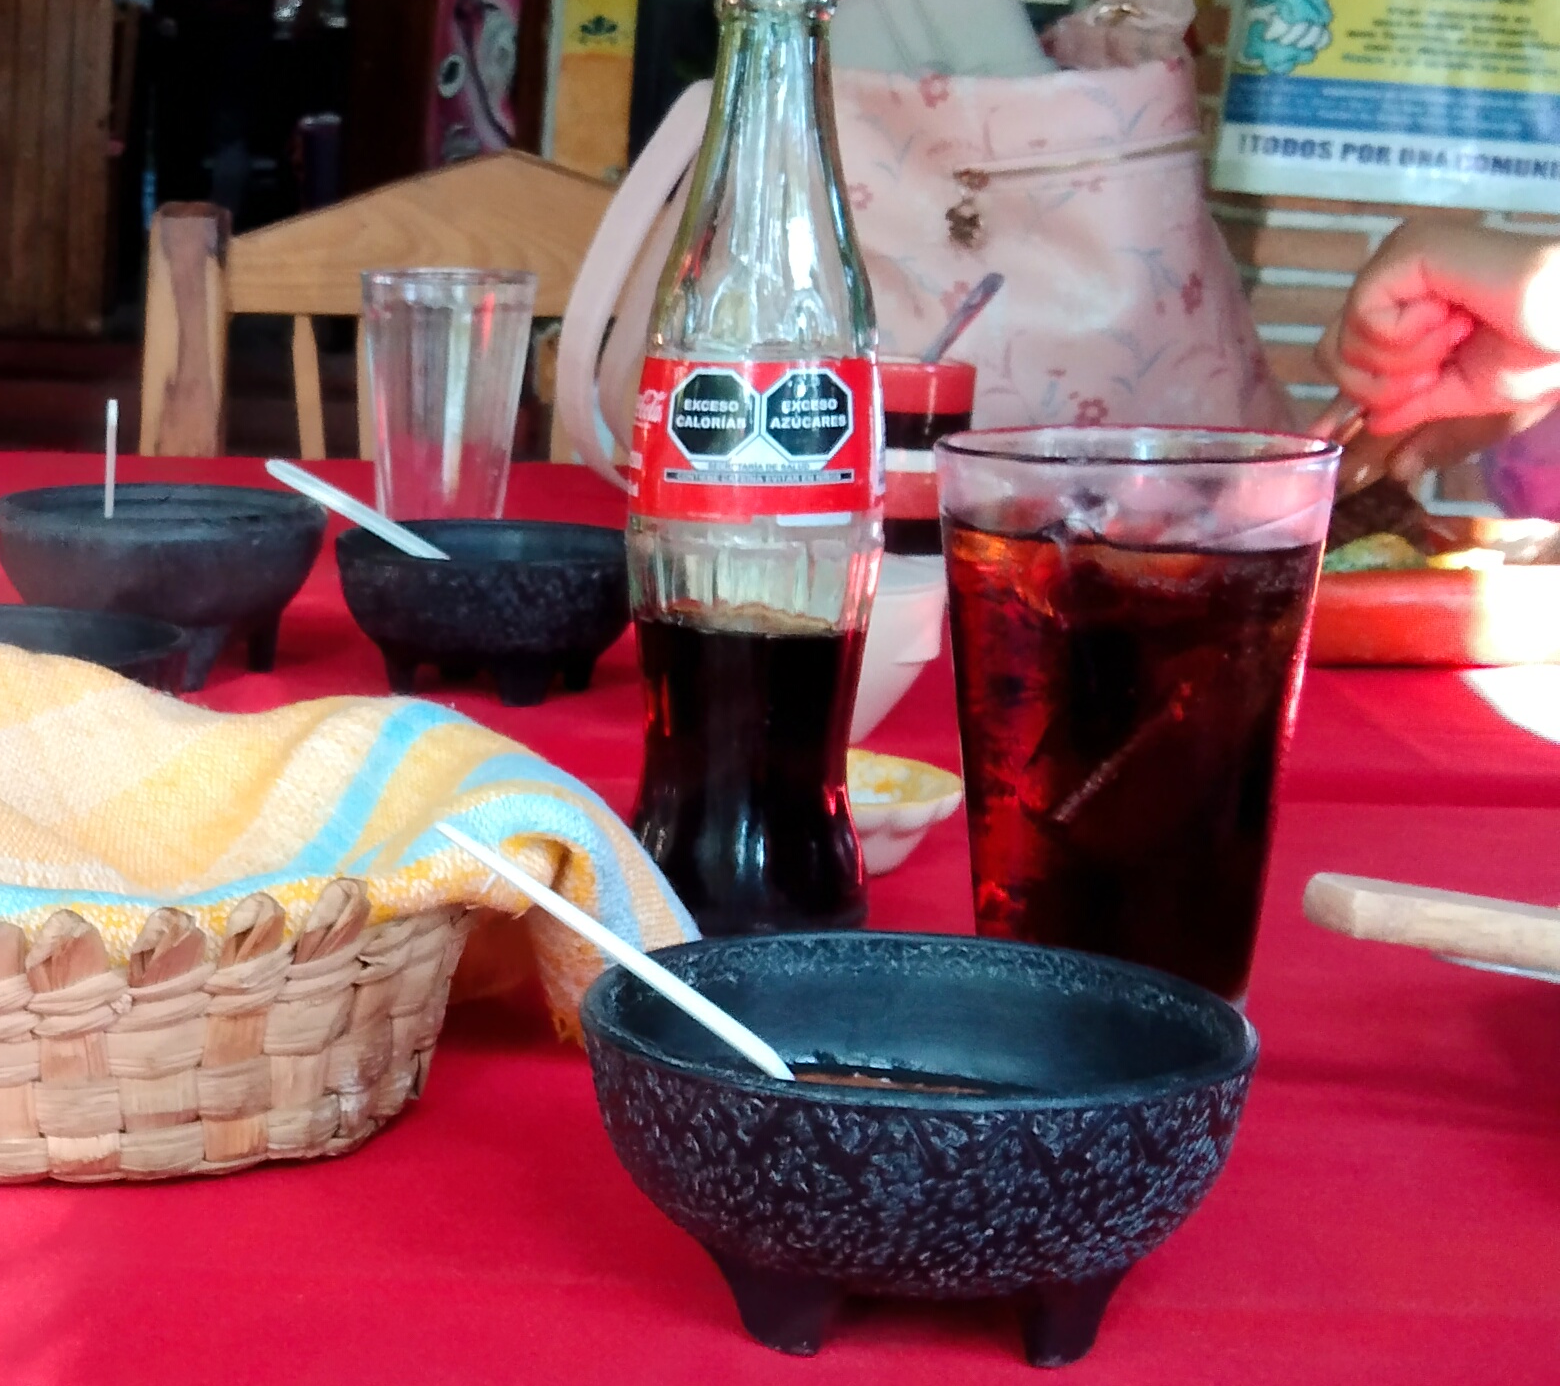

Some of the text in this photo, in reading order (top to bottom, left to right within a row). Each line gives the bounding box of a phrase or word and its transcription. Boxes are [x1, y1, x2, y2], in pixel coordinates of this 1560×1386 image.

[1341, 142, 1391, 166] POR
[684, 399, 739, 413] EXCESO
[781, 398, 839, 414] EXCESO
[675, 414, 747, 430] CALORÍAS
[769, 414, 847, 430] AZÚCARES
